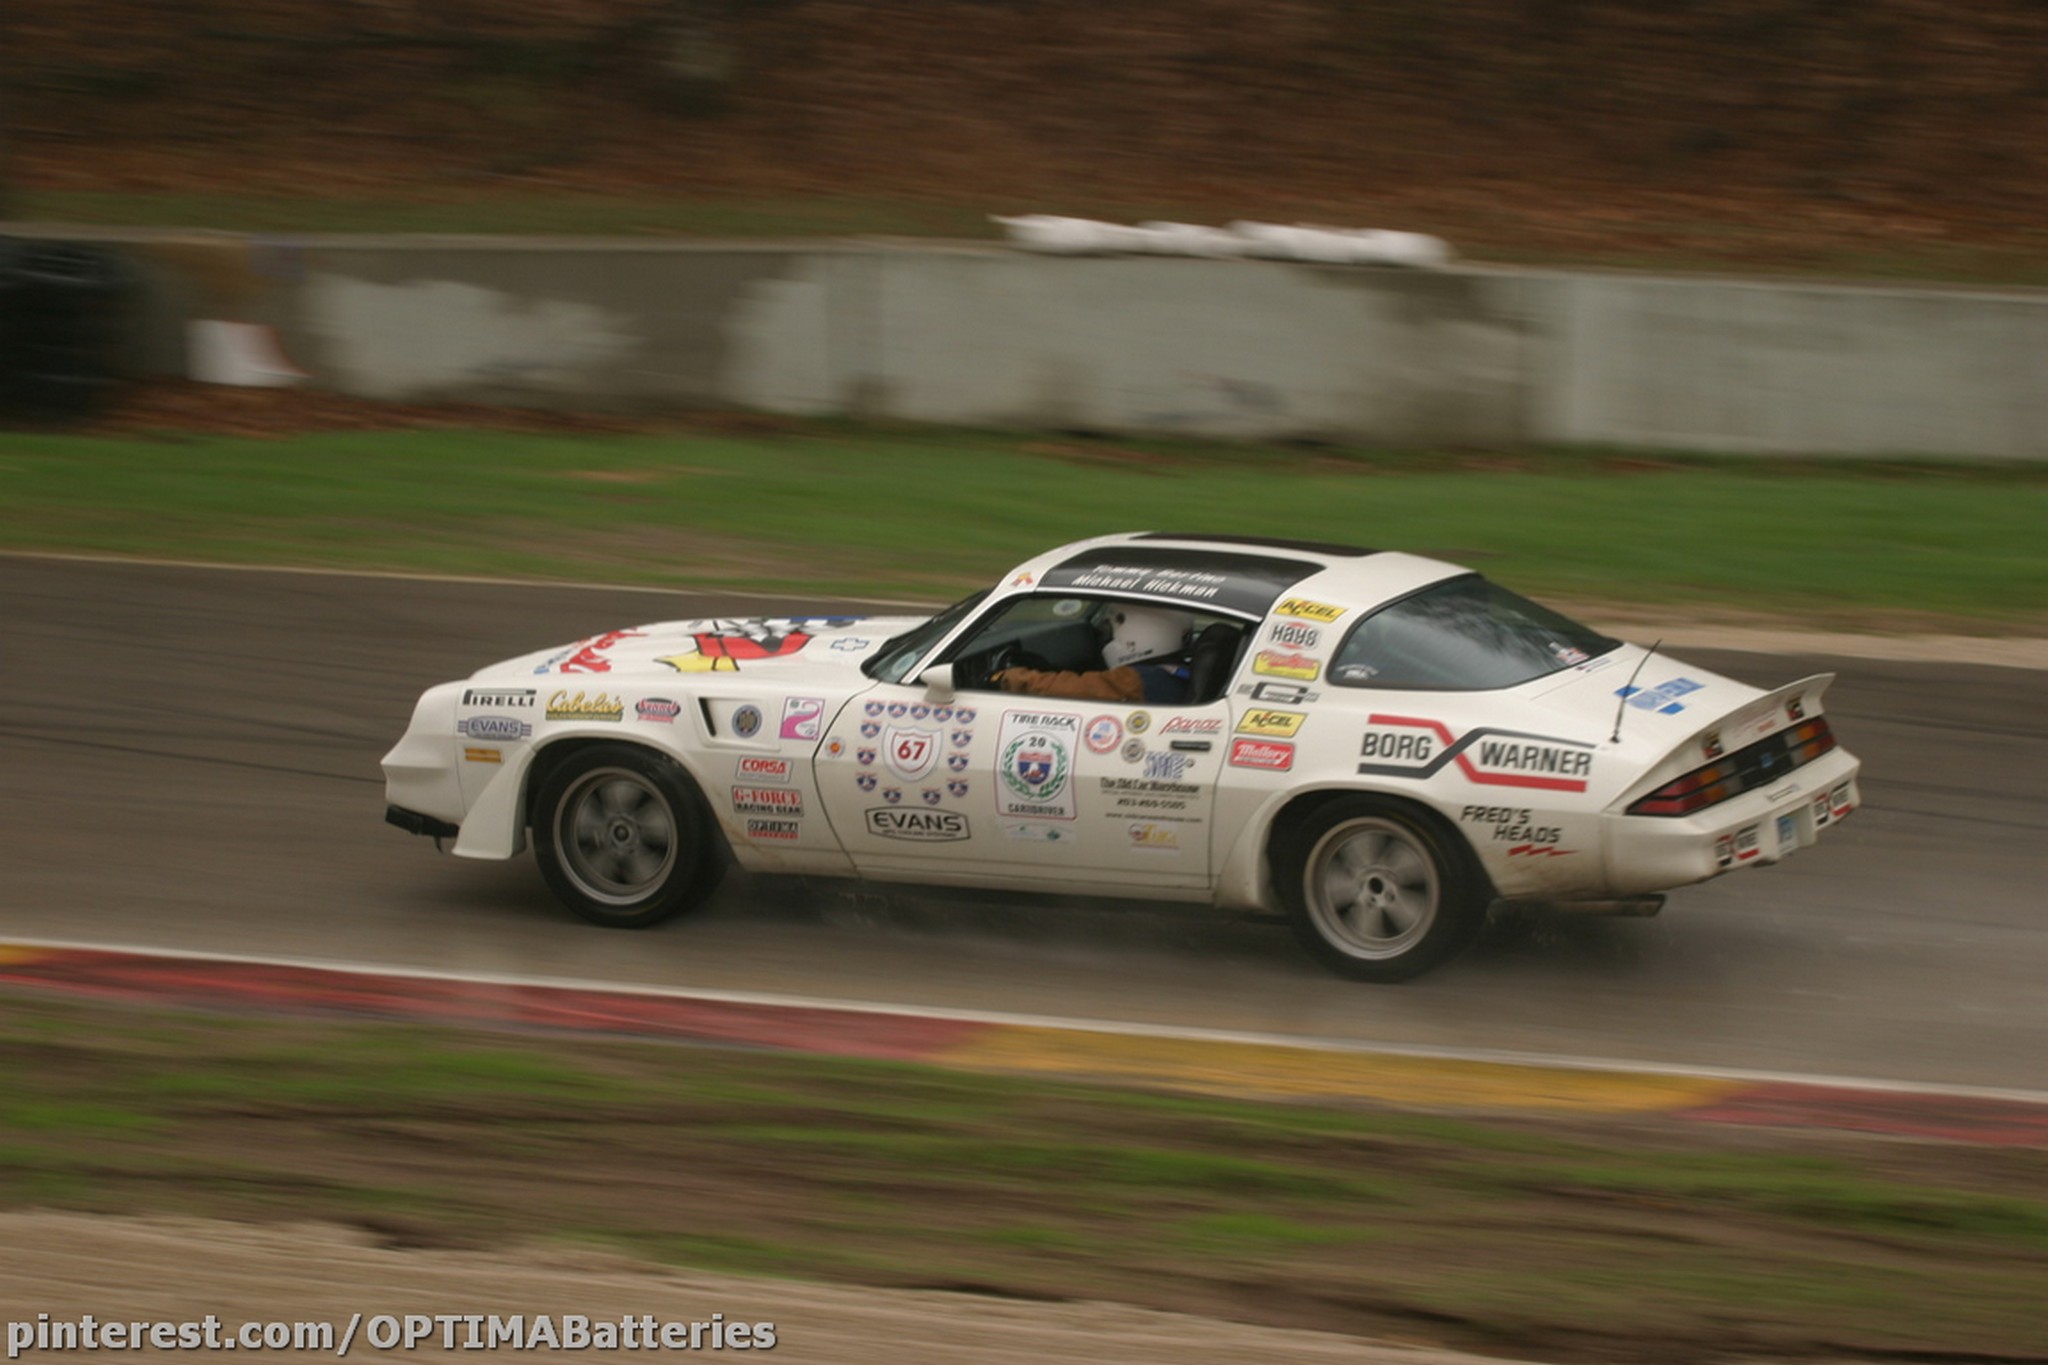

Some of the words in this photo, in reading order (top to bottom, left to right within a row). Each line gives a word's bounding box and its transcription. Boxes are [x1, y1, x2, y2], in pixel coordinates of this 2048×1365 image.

[1071, 573, 1140, 590] Michael
[1143, 578, 1220, 598] Hickman
[1281, 600, 1336, 618] ACCEL
[462, 689, 537, 707] PIRELLI
[546, 690, 624, 713] Cabela's
[470, 719, 519, 735] EVANS
[1011, 714, 1038, 725] TIRE
[1040, 716, 1075, 731] RACK
[1249, 713, 1293, 728] ACCEL
[897, 740, 926, 760] 67
[1360, 732, 1433, 761] BORG
[1479, 741, 1593, 776] WARNER
[741, 758, 786, 774] CORSA
[735, 788, 799, 806] G-FORCE
[736, 802, 774, 813] RACING
[1460, 804, 1532, 825] FRED'S
[872, 811, 962, 832] EVANS
[1493, 825, 1562, 844] HEADS
